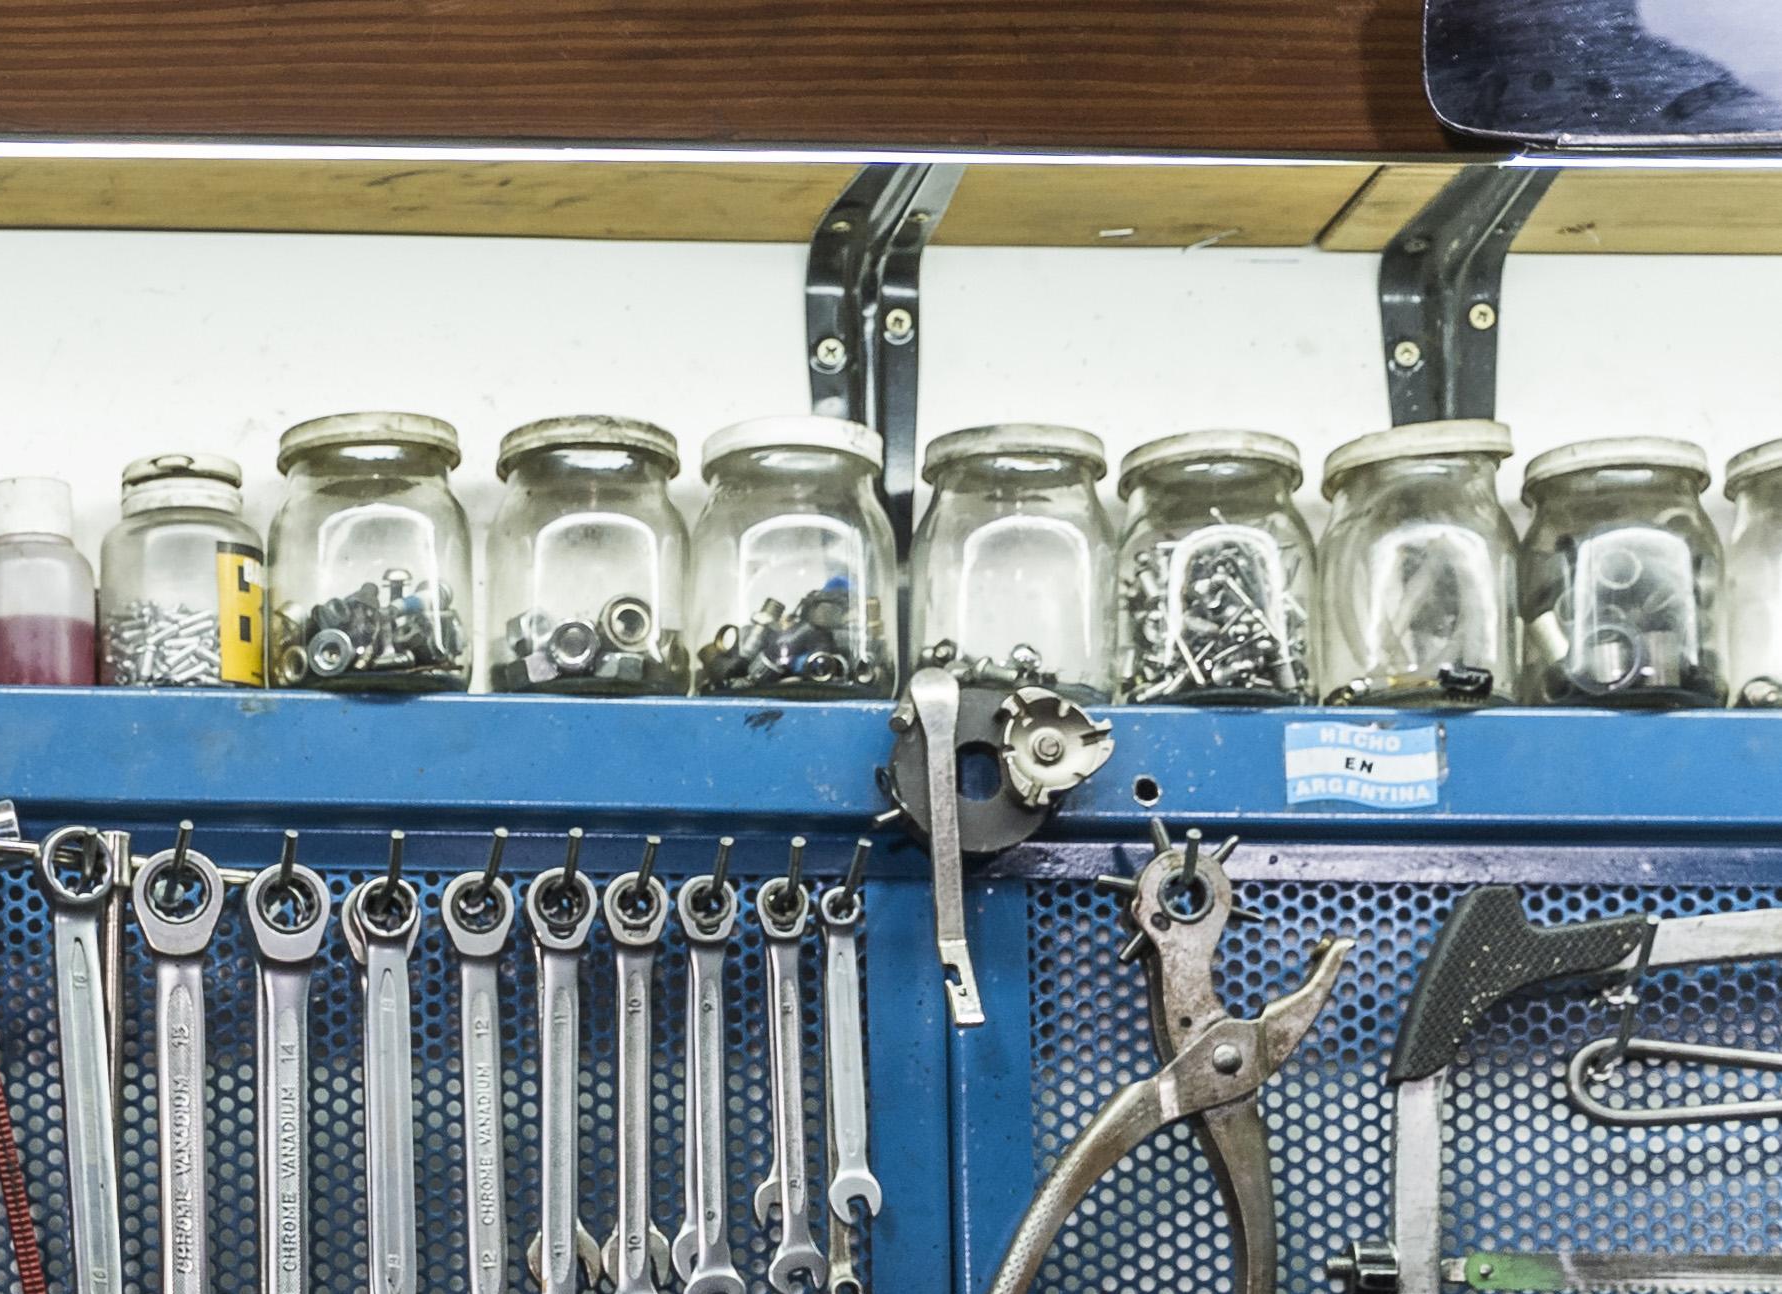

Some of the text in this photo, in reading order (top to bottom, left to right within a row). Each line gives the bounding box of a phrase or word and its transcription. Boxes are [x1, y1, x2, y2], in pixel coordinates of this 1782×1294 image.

[1319, 726, 1402, 753] HECHO
[1345, 757, 1374, 773] EN
[1295, 776, 1432, 802] ARGENTINA
[628, 997, 642, 1016] 10
[280, 1042, 296, 1064] 14
[172, 1074, 192, 1176] VANADIUM
[280, 1086, 296, 1179] VANADIUM
[474, 1019, 497, 1271] 12 CHROME VANADIUM 12
[281, 1192, 297, 1273] CHROME
[628, 1235, 642, 1253] 10
